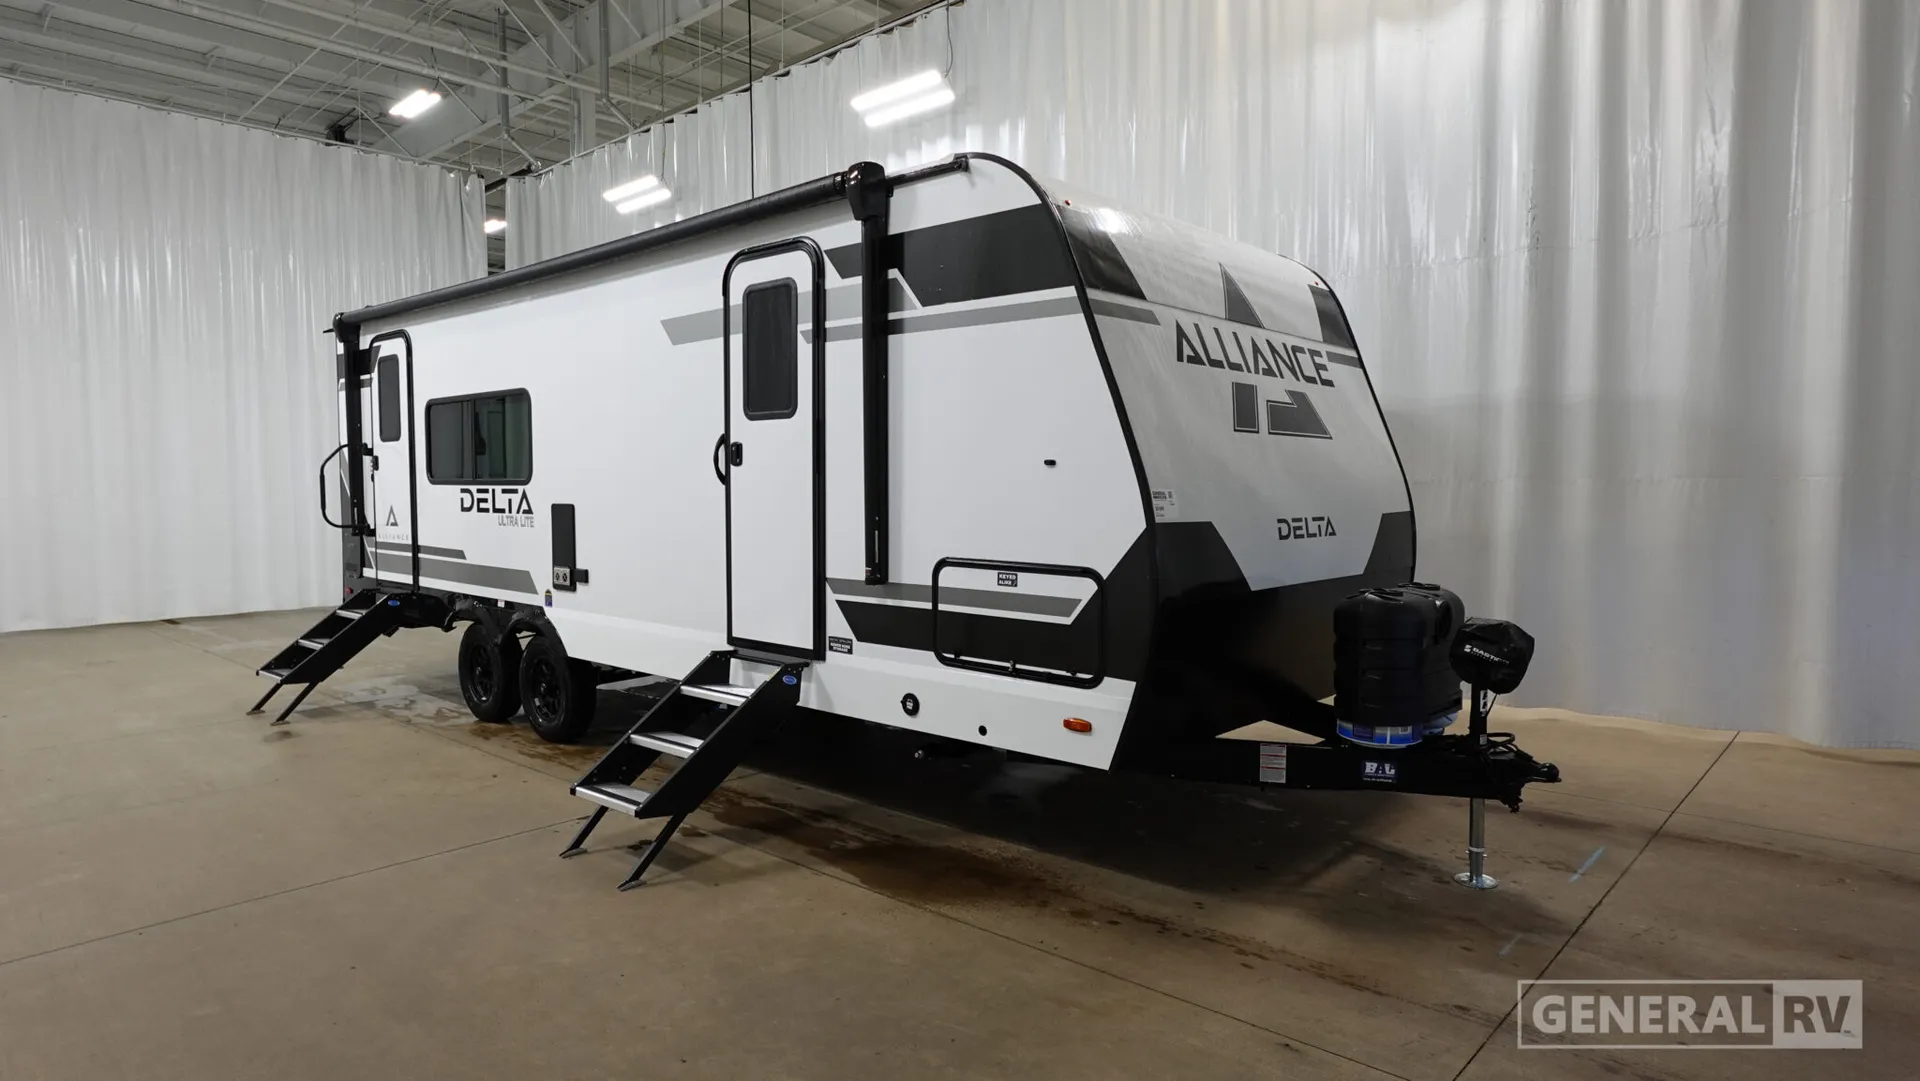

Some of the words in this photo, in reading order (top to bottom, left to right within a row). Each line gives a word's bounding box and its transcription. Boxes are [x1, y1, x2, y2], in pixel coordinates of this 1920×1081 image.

[1175, 319, 1336, 388] ALLIANCE
[460, 488, 534, 515] DELTA
[498, 514, 519, 528] ULTRA
[520, 515, 535, 529] LITE
[1276, 515, 1338, 541] DELTA
